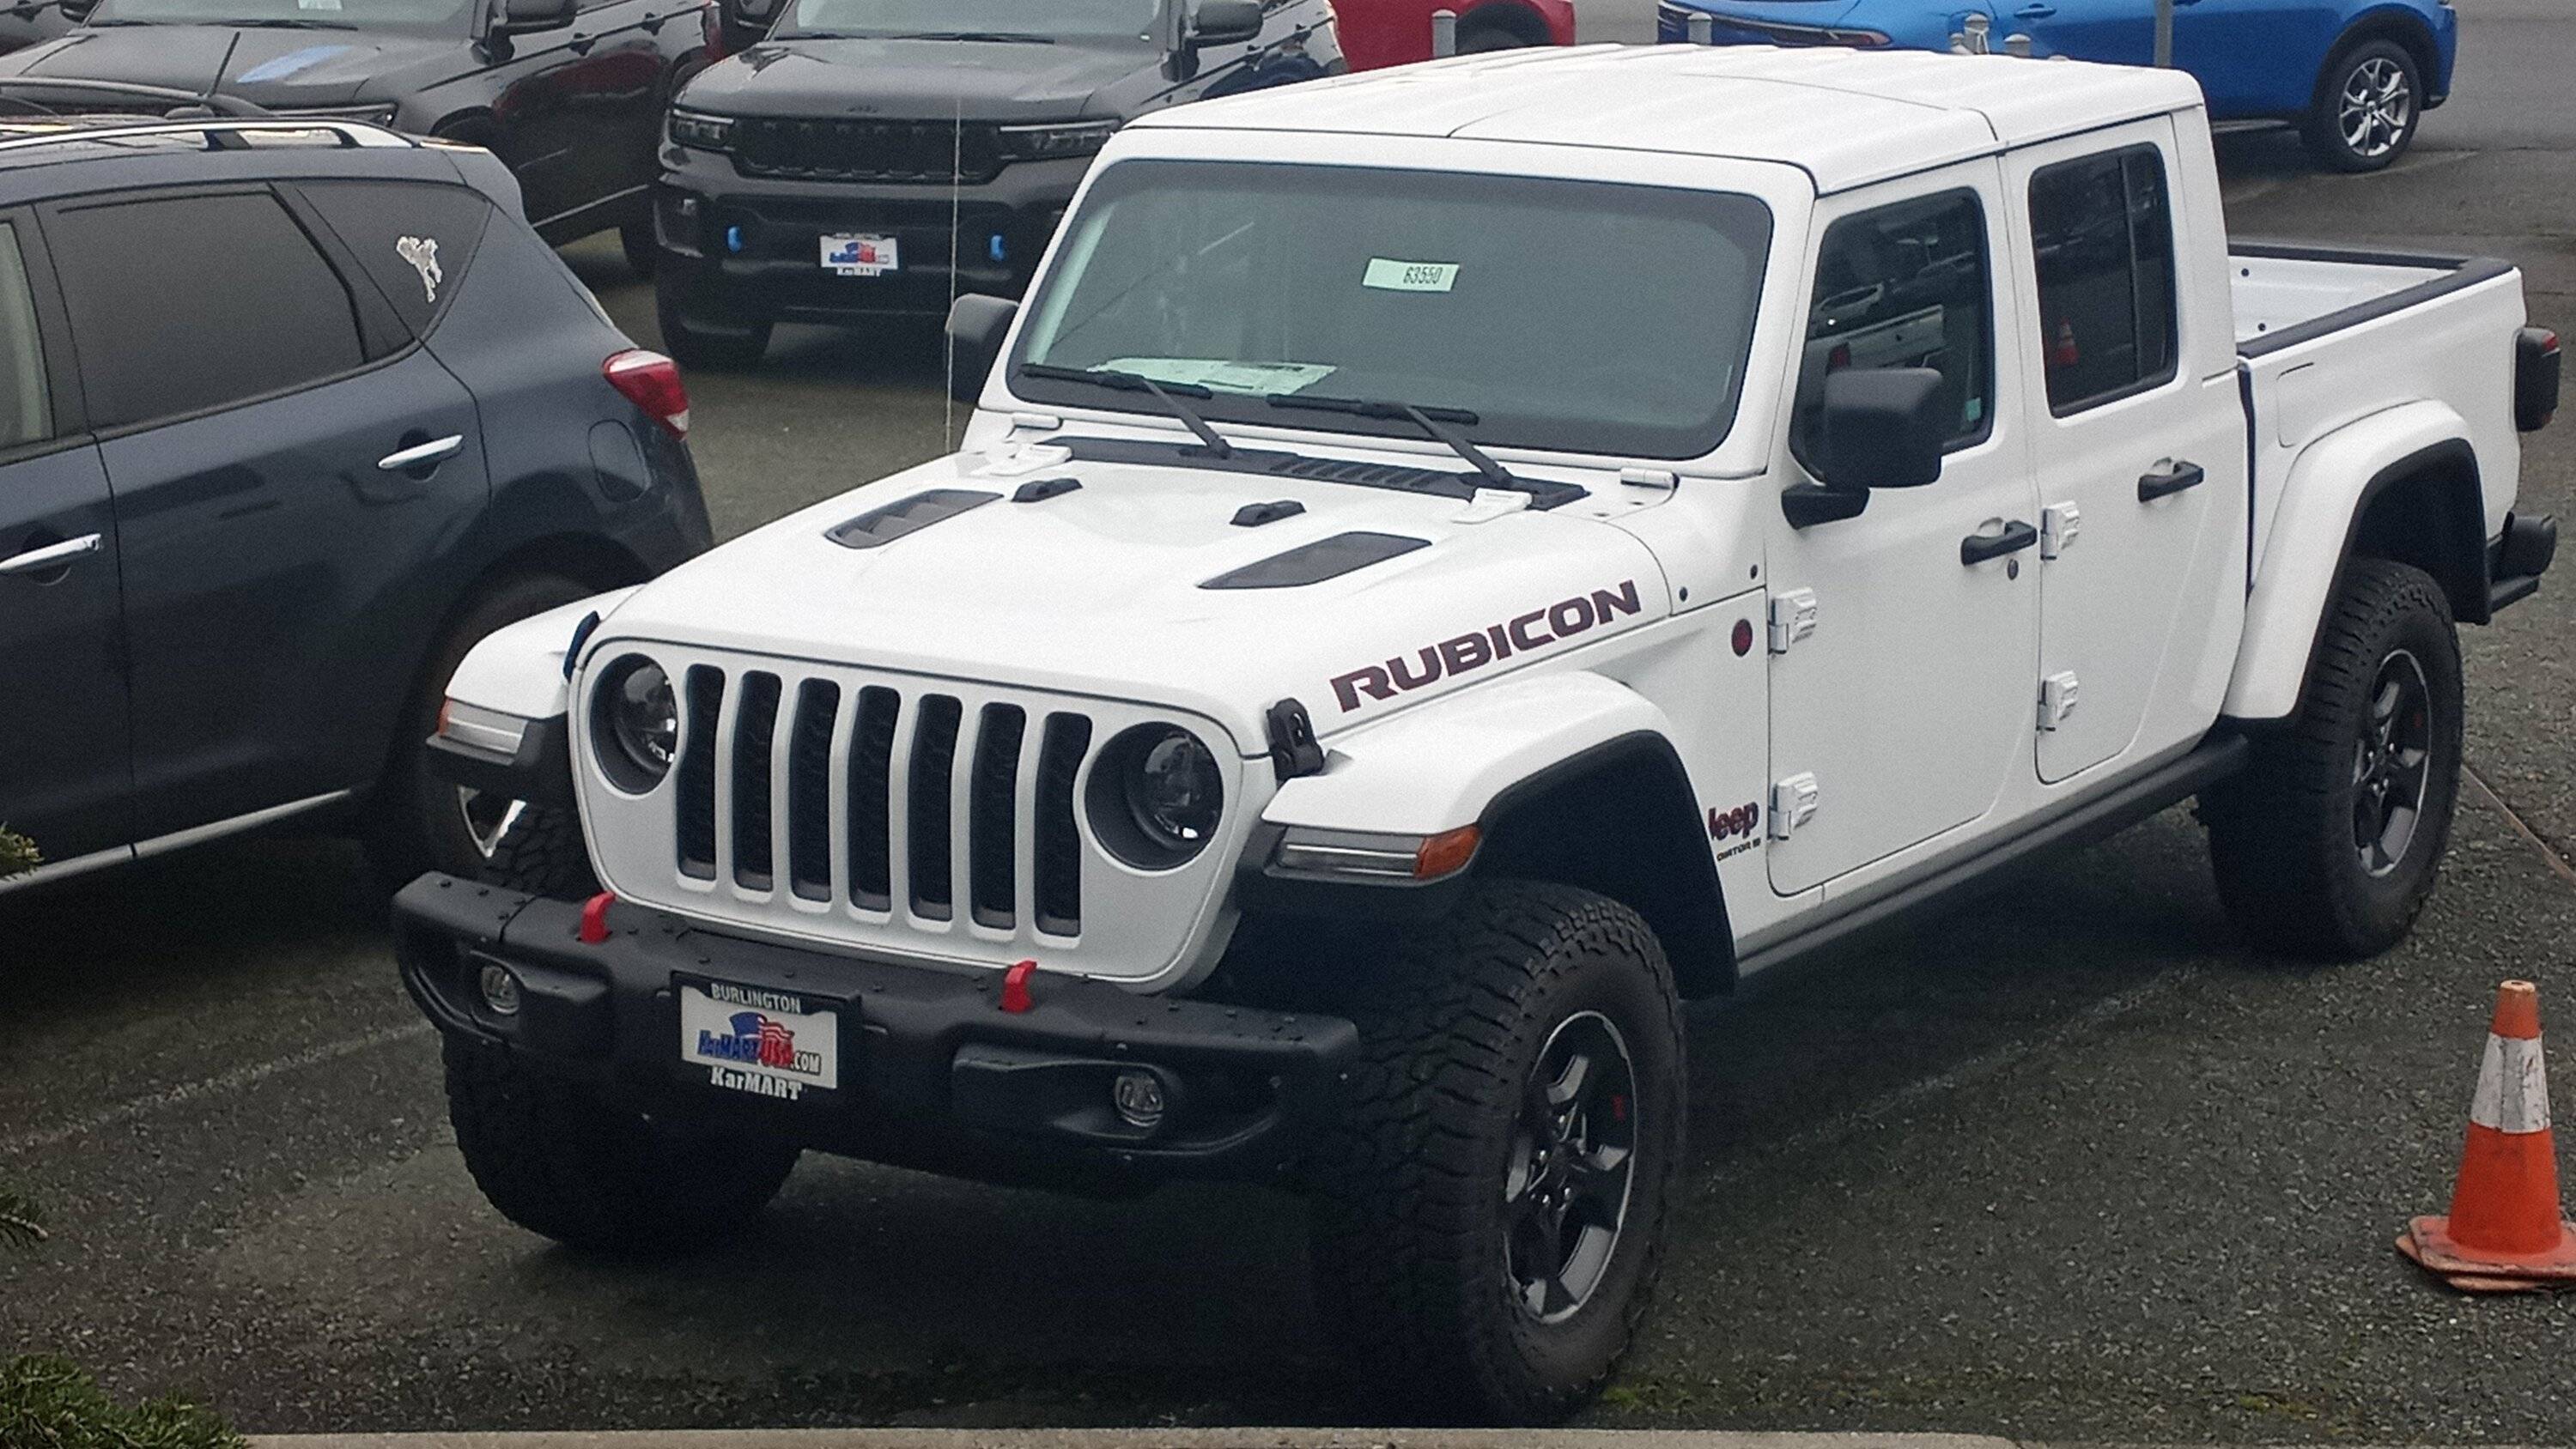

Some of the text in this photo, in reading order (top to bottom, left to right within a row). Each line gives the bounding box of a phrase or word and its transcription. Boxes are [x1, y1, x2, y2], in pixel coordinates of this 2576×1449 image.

[1330, 579, 1641, 713] RUBICON
[1709, 801, 1759, 840] Jeep
[711, 983, 801, 1014] BURLINGTON
[710, 1067, 803, 1100] KarMART
